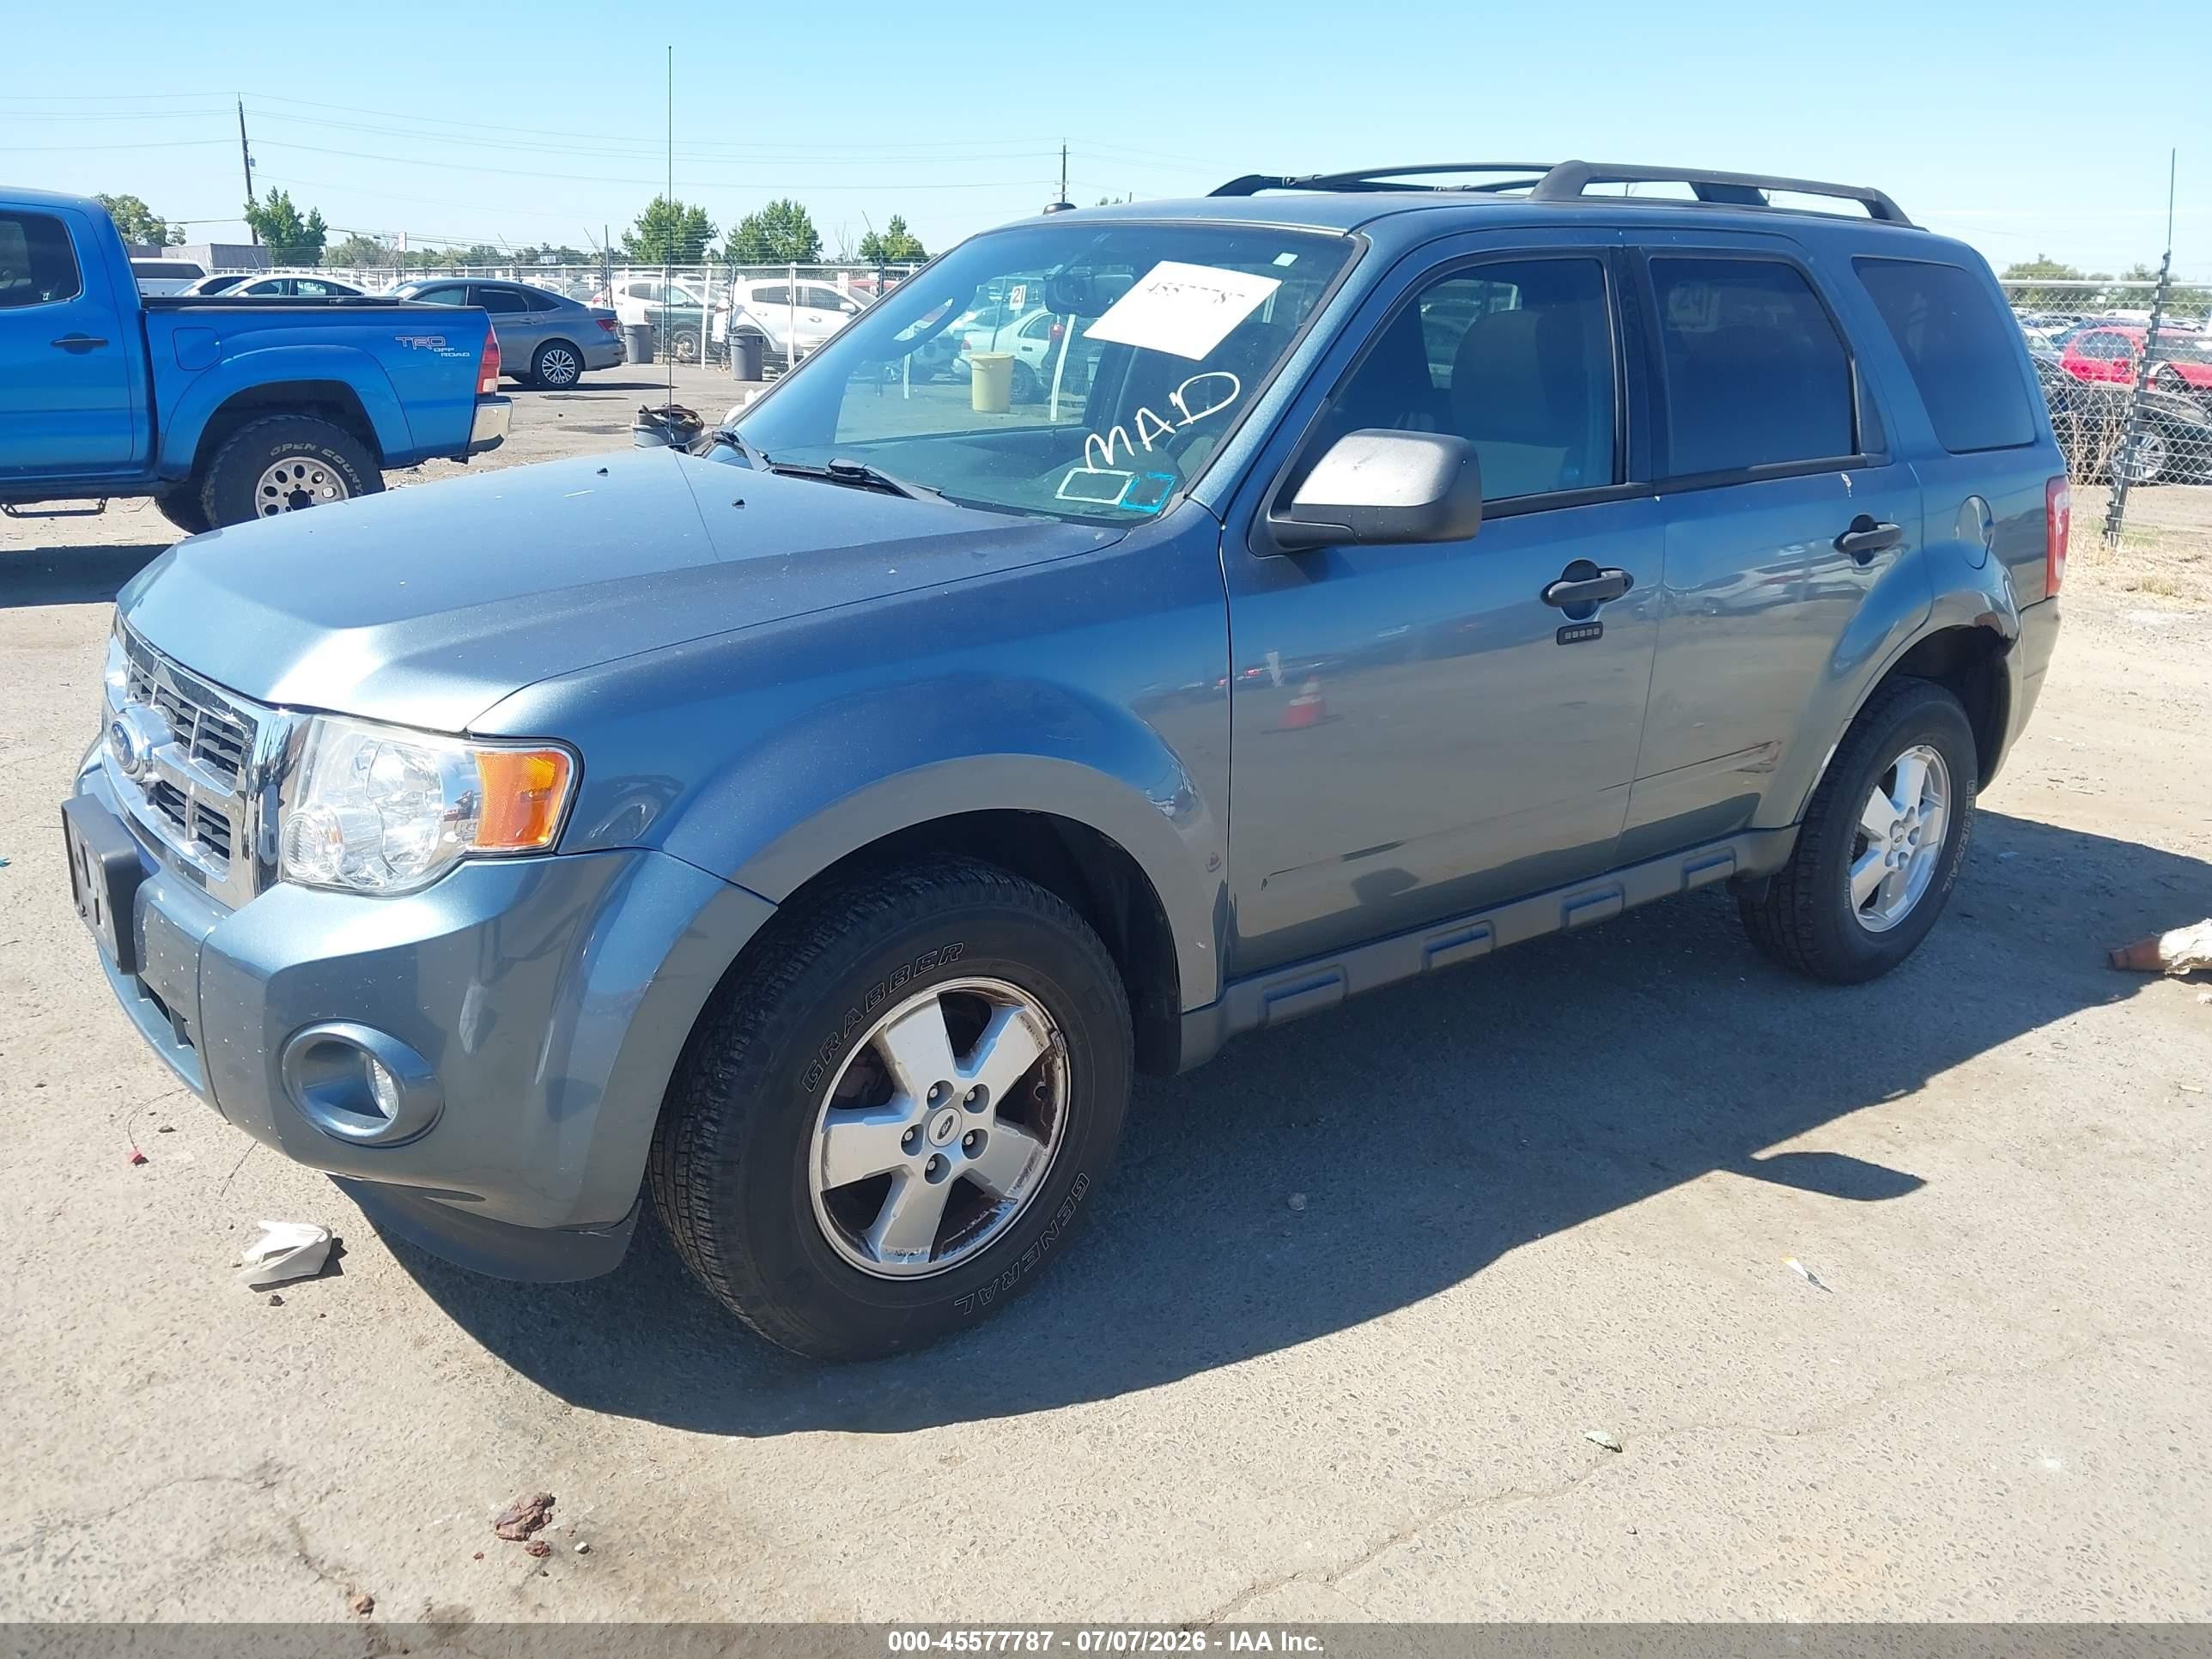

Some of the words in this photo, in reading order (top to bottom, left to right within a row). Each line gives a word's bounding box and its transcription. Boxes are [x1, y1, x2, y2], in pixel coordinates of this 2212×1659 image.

[395, 336, 446, 350] TRD
[270, 442, 317, 457] OPEN
[1085, 372, 1241, 473] MAD
[801, 942, 965, 1094] GRABBER
[954, 1172, 1091, 1316] GENERAL
